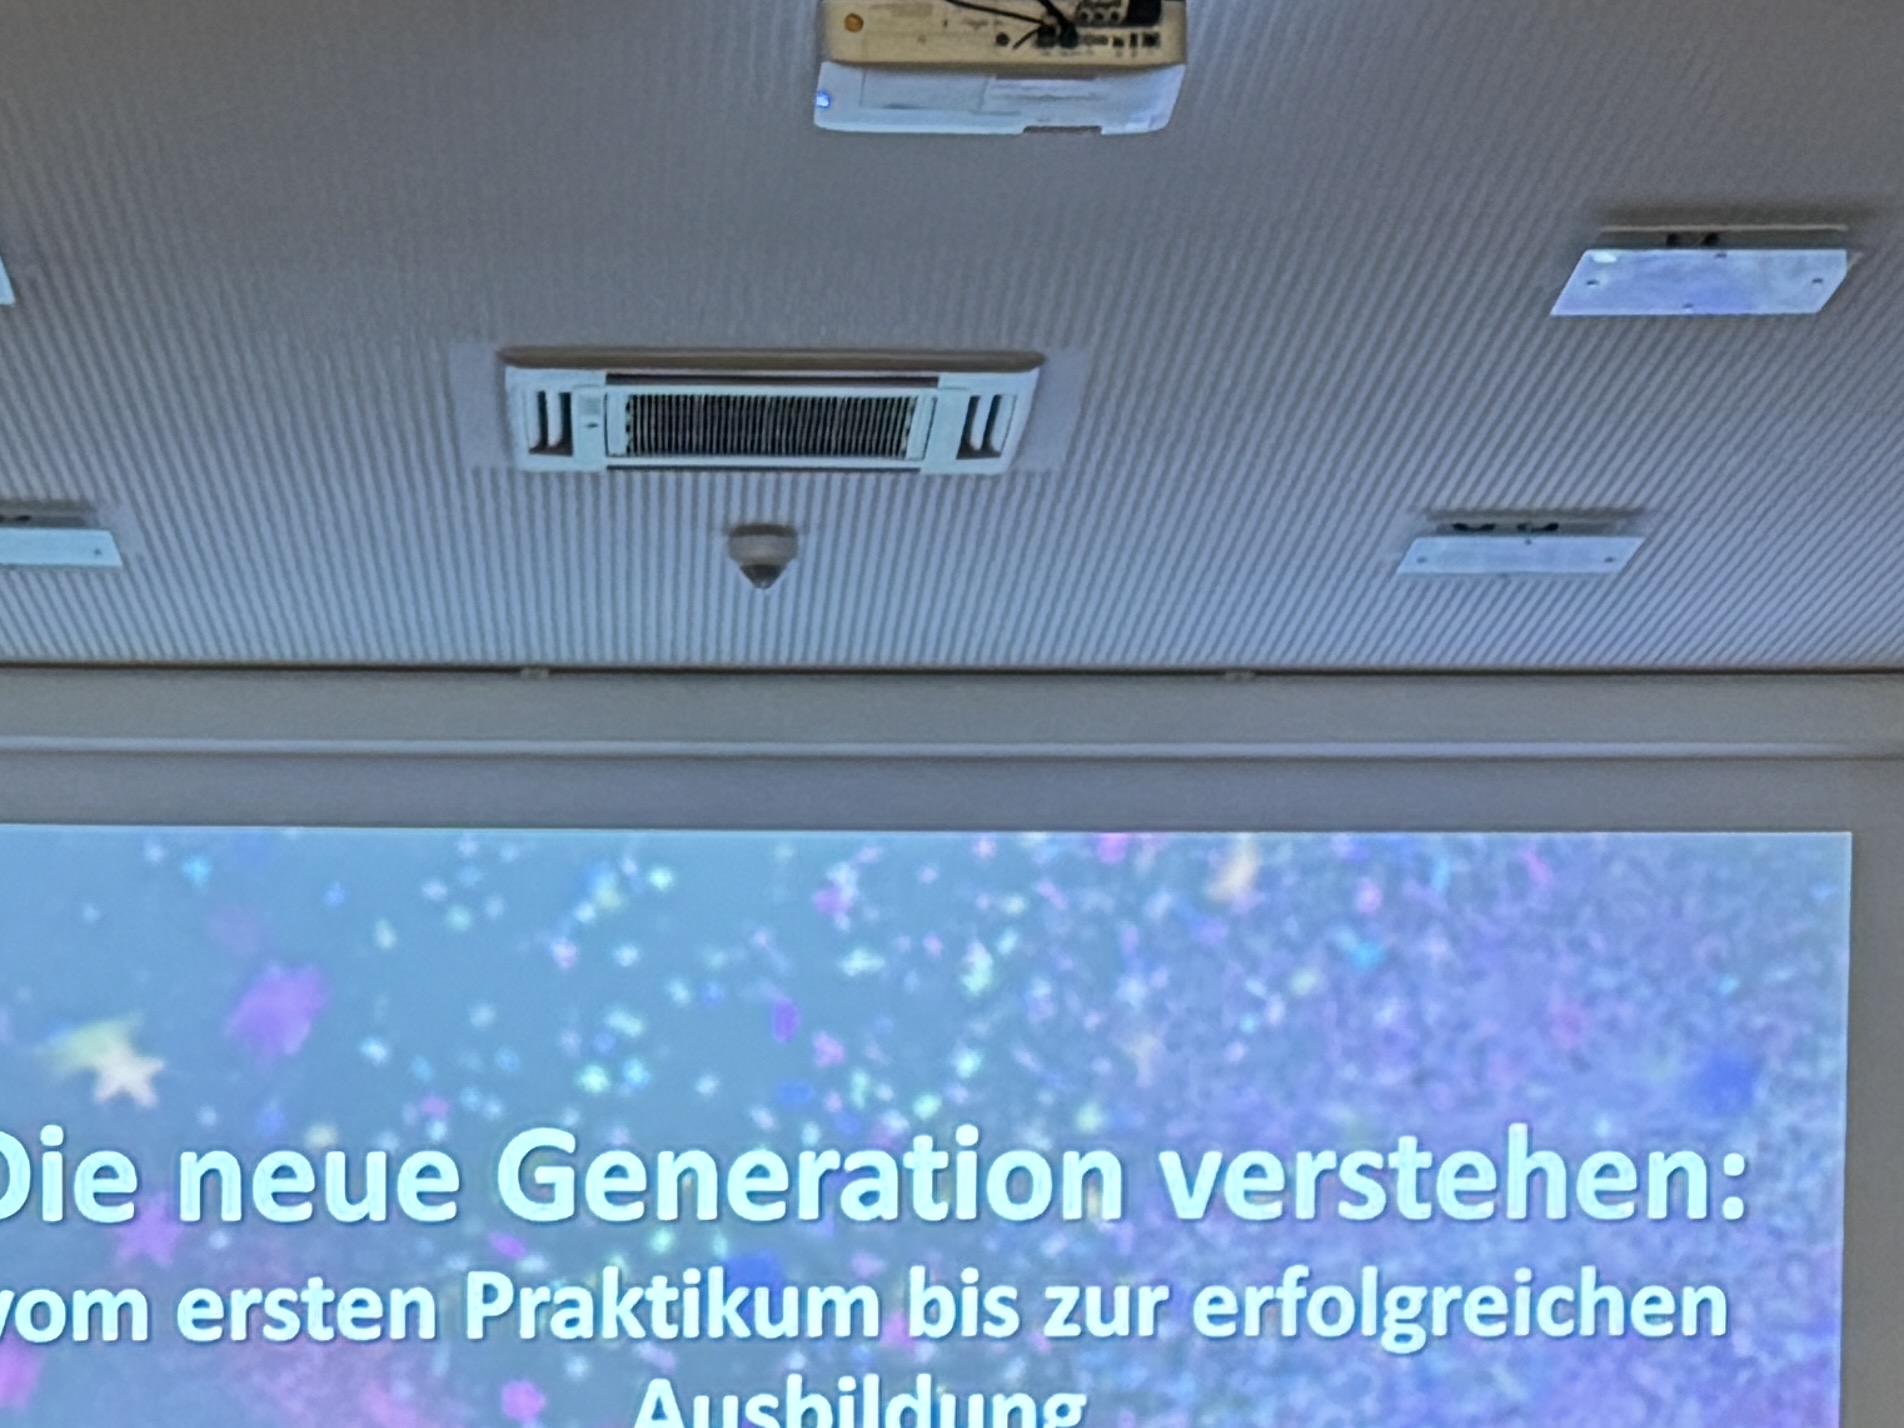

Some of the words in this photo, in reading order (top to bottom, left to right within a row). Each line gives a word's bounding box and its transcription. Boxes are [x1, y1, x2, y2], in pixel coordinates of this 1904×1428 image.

[179, 1149, 461, 1224] neue
[496, 1124, 1123, 1222] Generation
[1158, 1122, 1746, 1222] verstehen:
[176, 1276, 437, 1343] ersten
[465, 1265, 881, 1340] Praktikum
[908, 1264, 1021, 1338] bis
[1042, 1280, 1170, 1337] zur
[1192, 1264, 1729, 1355] erfolgreichen
